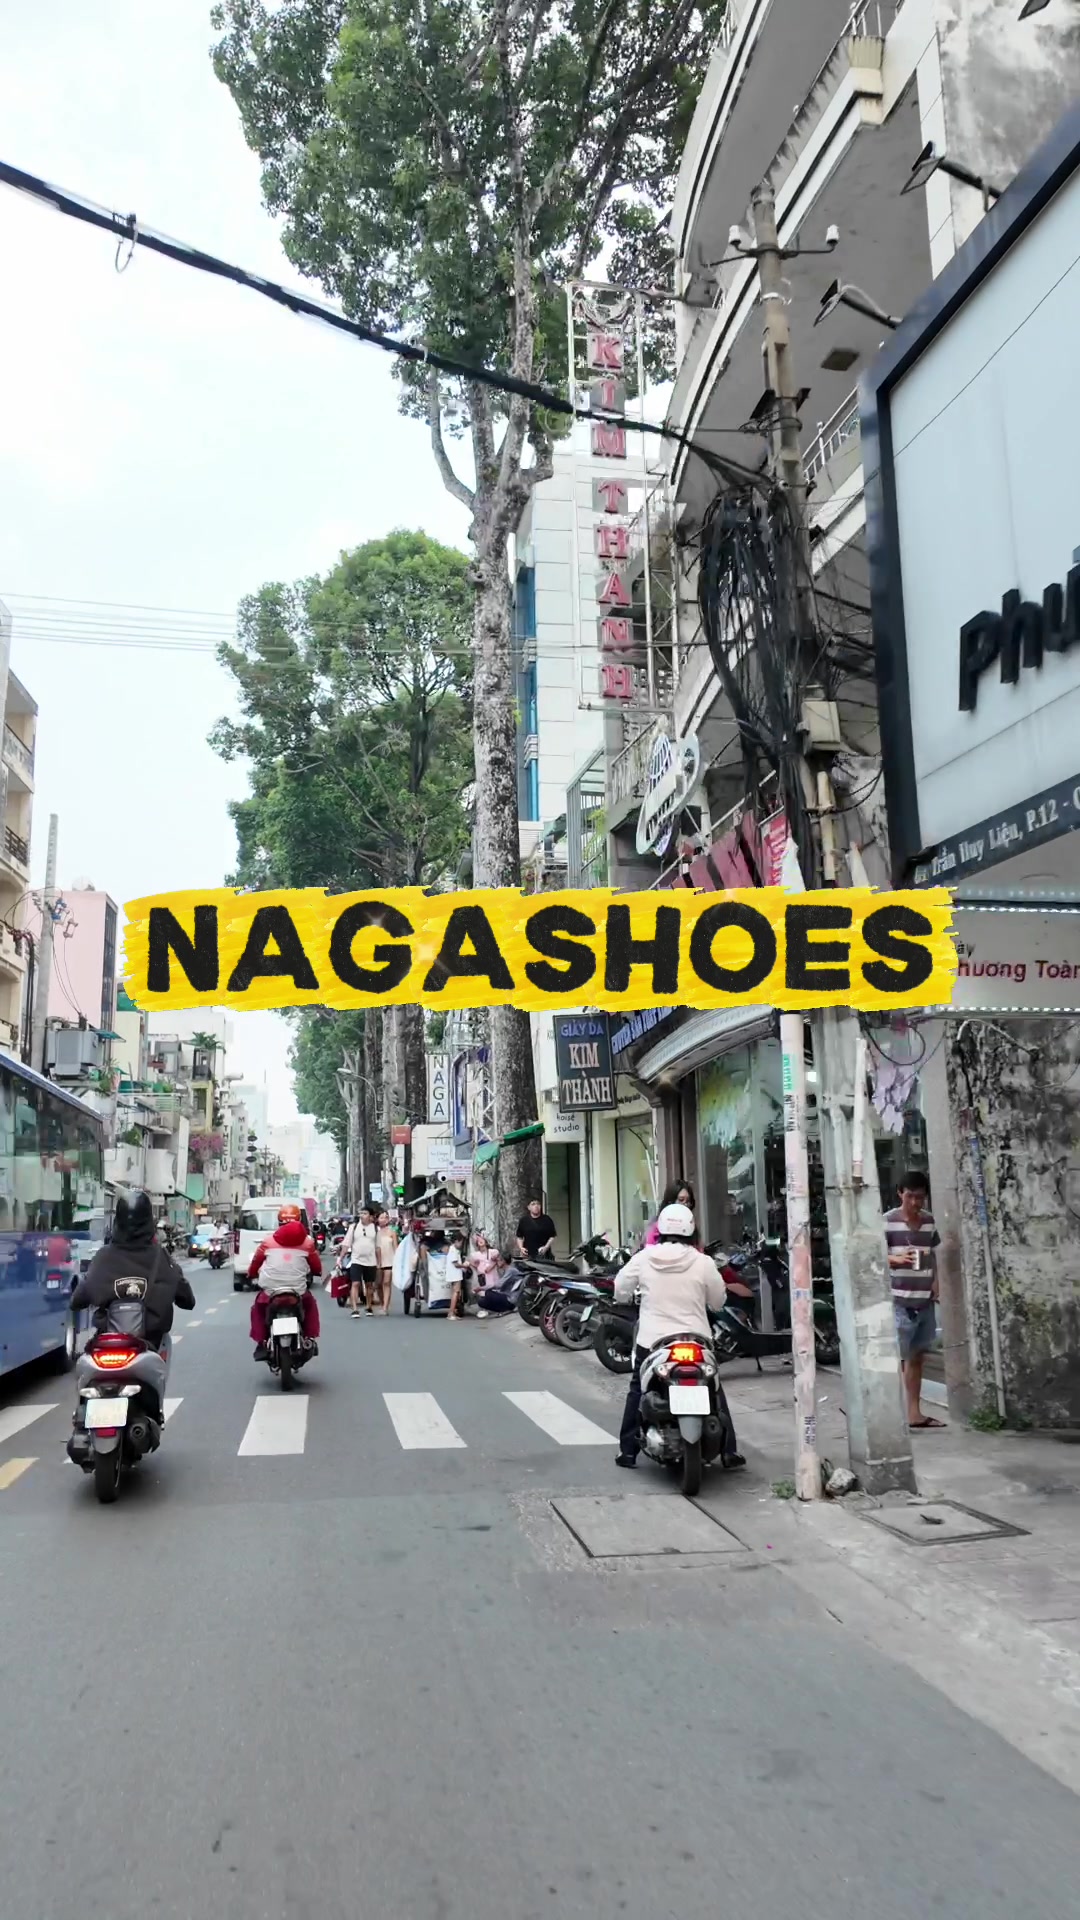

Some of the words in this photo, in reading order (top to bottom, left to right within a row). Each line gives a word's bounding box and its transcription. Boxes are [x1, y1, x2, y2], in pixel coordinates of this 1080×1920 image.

[592, 333, 626, 458] KIM
[959, 839, 984, 863] Huy
[1026, 799, 1059, 833] P.12
[589, 1022, 605, 1036] DA
[568, 1042, 600, 1069] KIM
[432, 1055, 445, 1116] NAGA
[562, 1070, 612, 1105] THÀNH
[553, 1122, 580, 1134] studio
